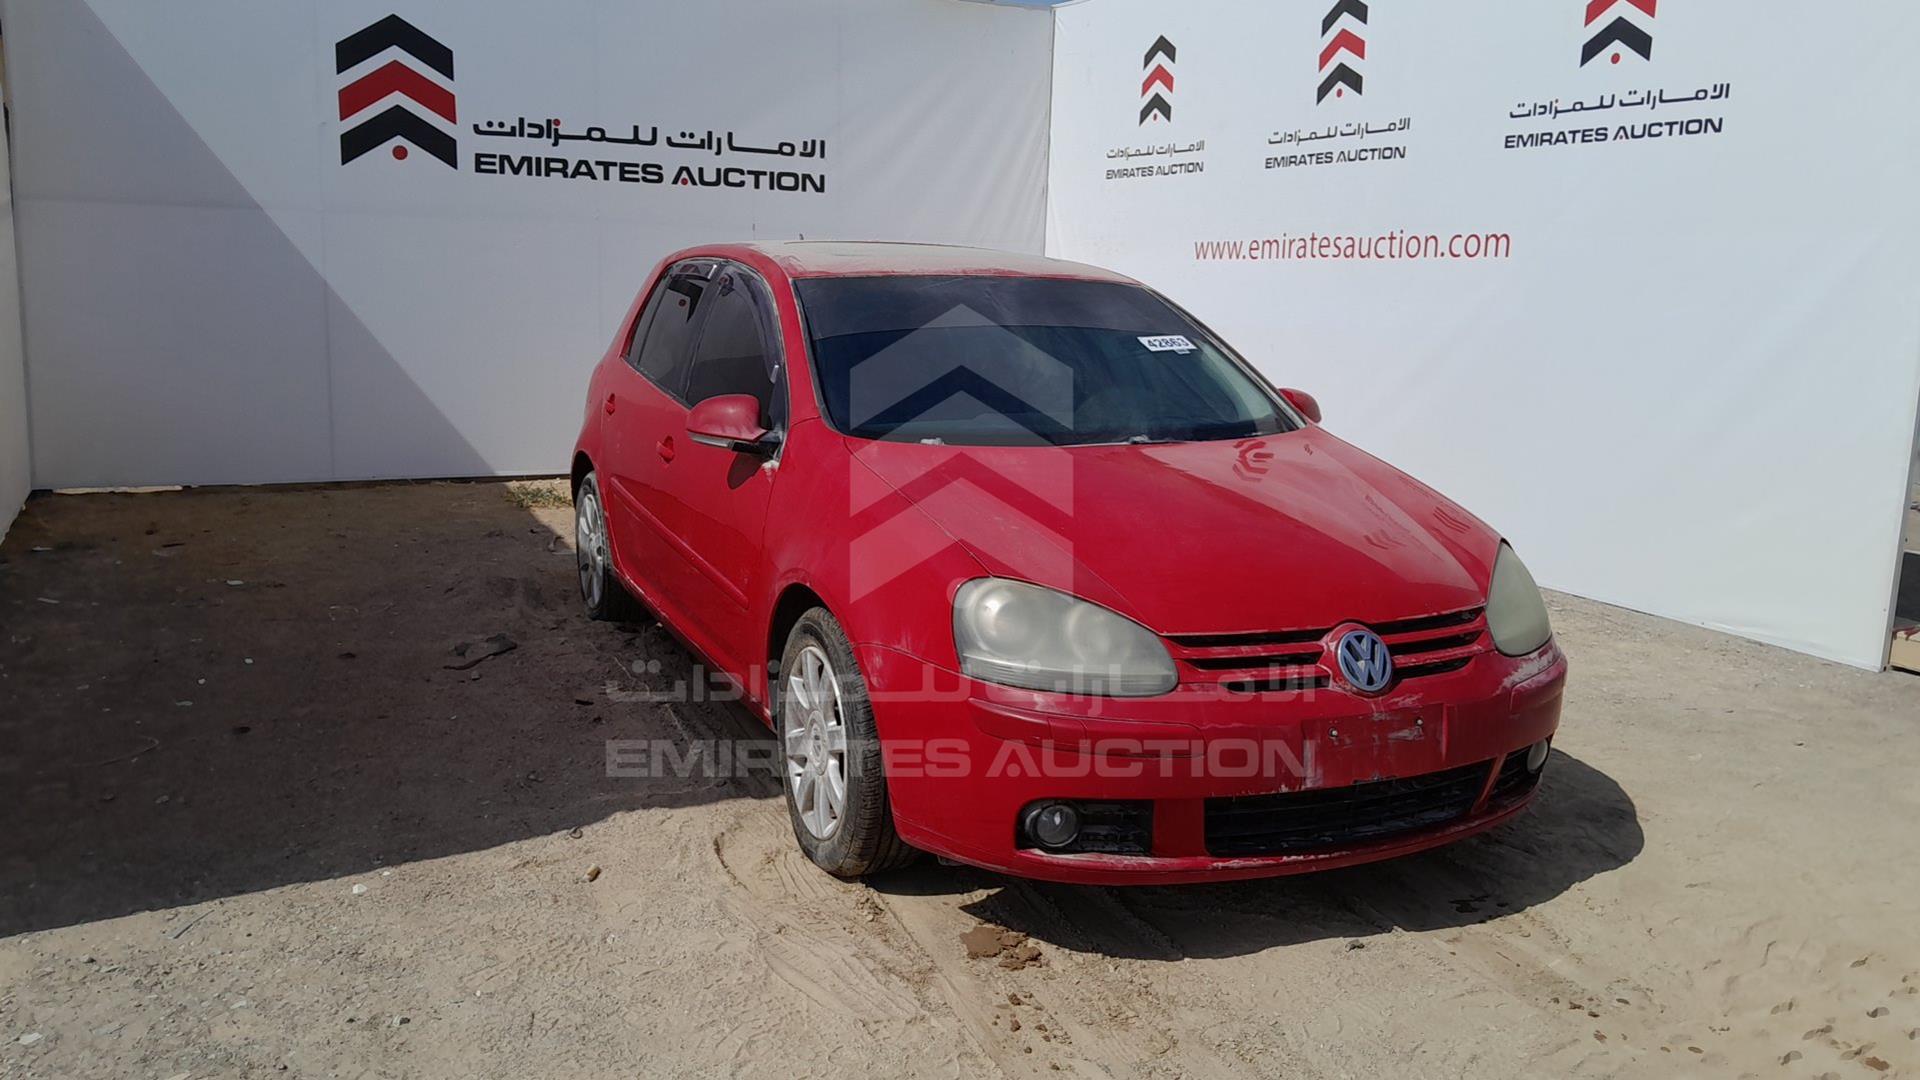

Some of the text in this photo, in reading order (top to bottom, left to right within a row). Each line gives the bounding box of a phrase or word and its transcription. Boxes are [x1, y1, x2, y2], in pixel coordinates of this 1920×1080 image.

[1509, 94, 1615, 119] للمزادات
[472, 117, 657, 147] للمزادات
[1504, 117, 1723, 149] EMIRATES AUCTION
[1105, 161, 1204, 180] EMIRATES AUCTION
[1264, 146, 1406, 169] EMIRATES AUCTION
[474, 153, 826, 193] EMIRATES AUCTION
[1194, 229, 1511, 260] www.emiratesauction.com
